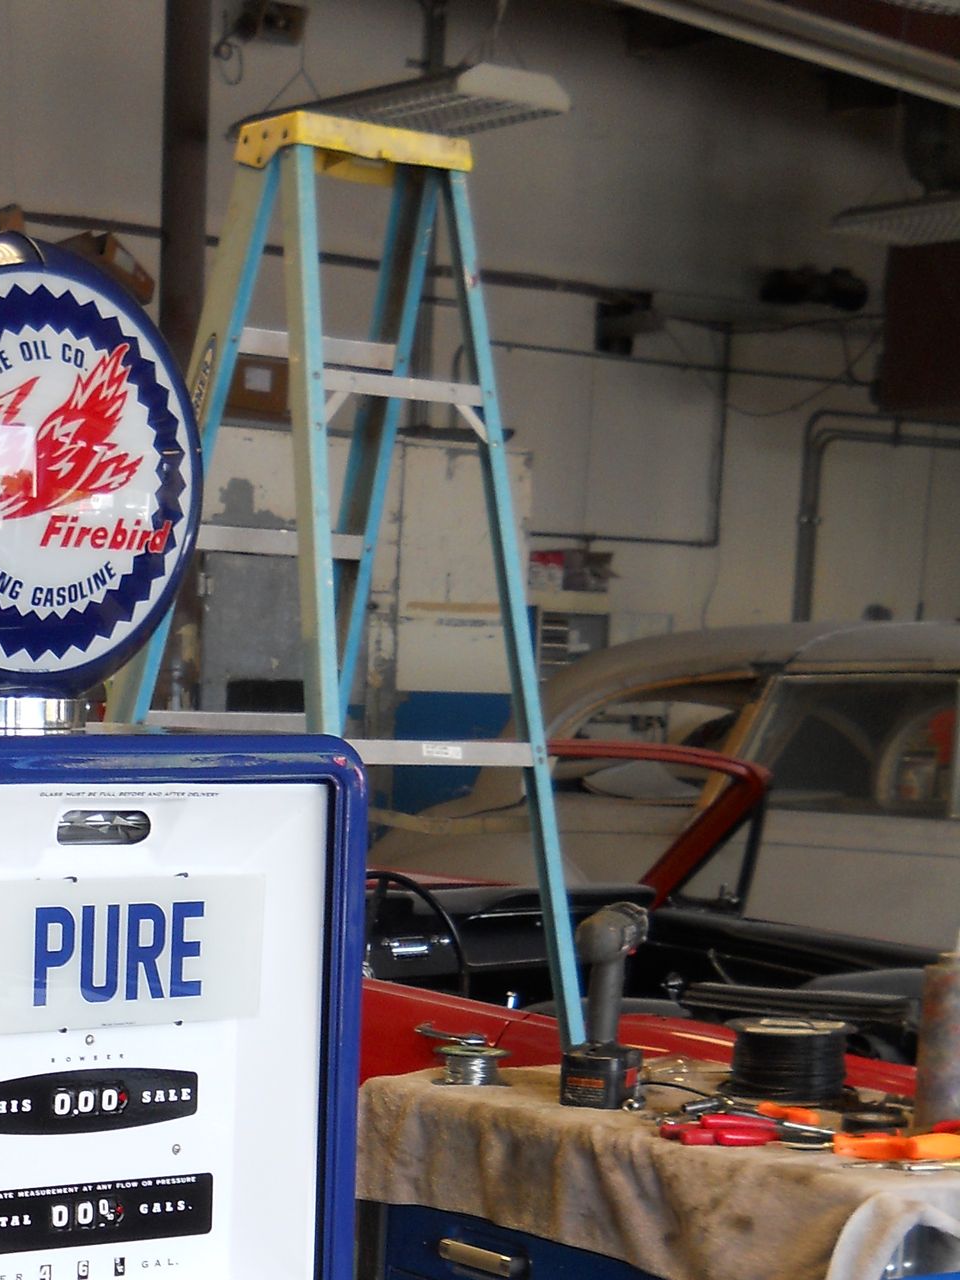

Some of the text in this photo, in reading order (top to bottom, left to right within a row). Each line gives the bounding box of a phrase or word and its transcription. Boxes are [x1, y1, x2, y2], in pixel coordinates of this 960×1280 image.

[19, 340, 51, 361] OIL
[61, 343, 88, 372] CO.
[40, 514, 173, 553] Firebird
[31, 561, 116, 607] GASOLINE
[32, 900, 206, 1008] PURE
[141, 1088, 191, 1104] SALE
[17, 1186, 79, 1198] MEASUREMENT
[82, 1184, 93, 1192] AT
[96, 1183, 113, 1191] ANY
[116, 1181, 138, 1189] FLOW
[156, 1176, 197, 1185] PRESSURE
[139, 1200, 193, 1214] GALS.
[141, 1258, 180, 1269] GAL.
